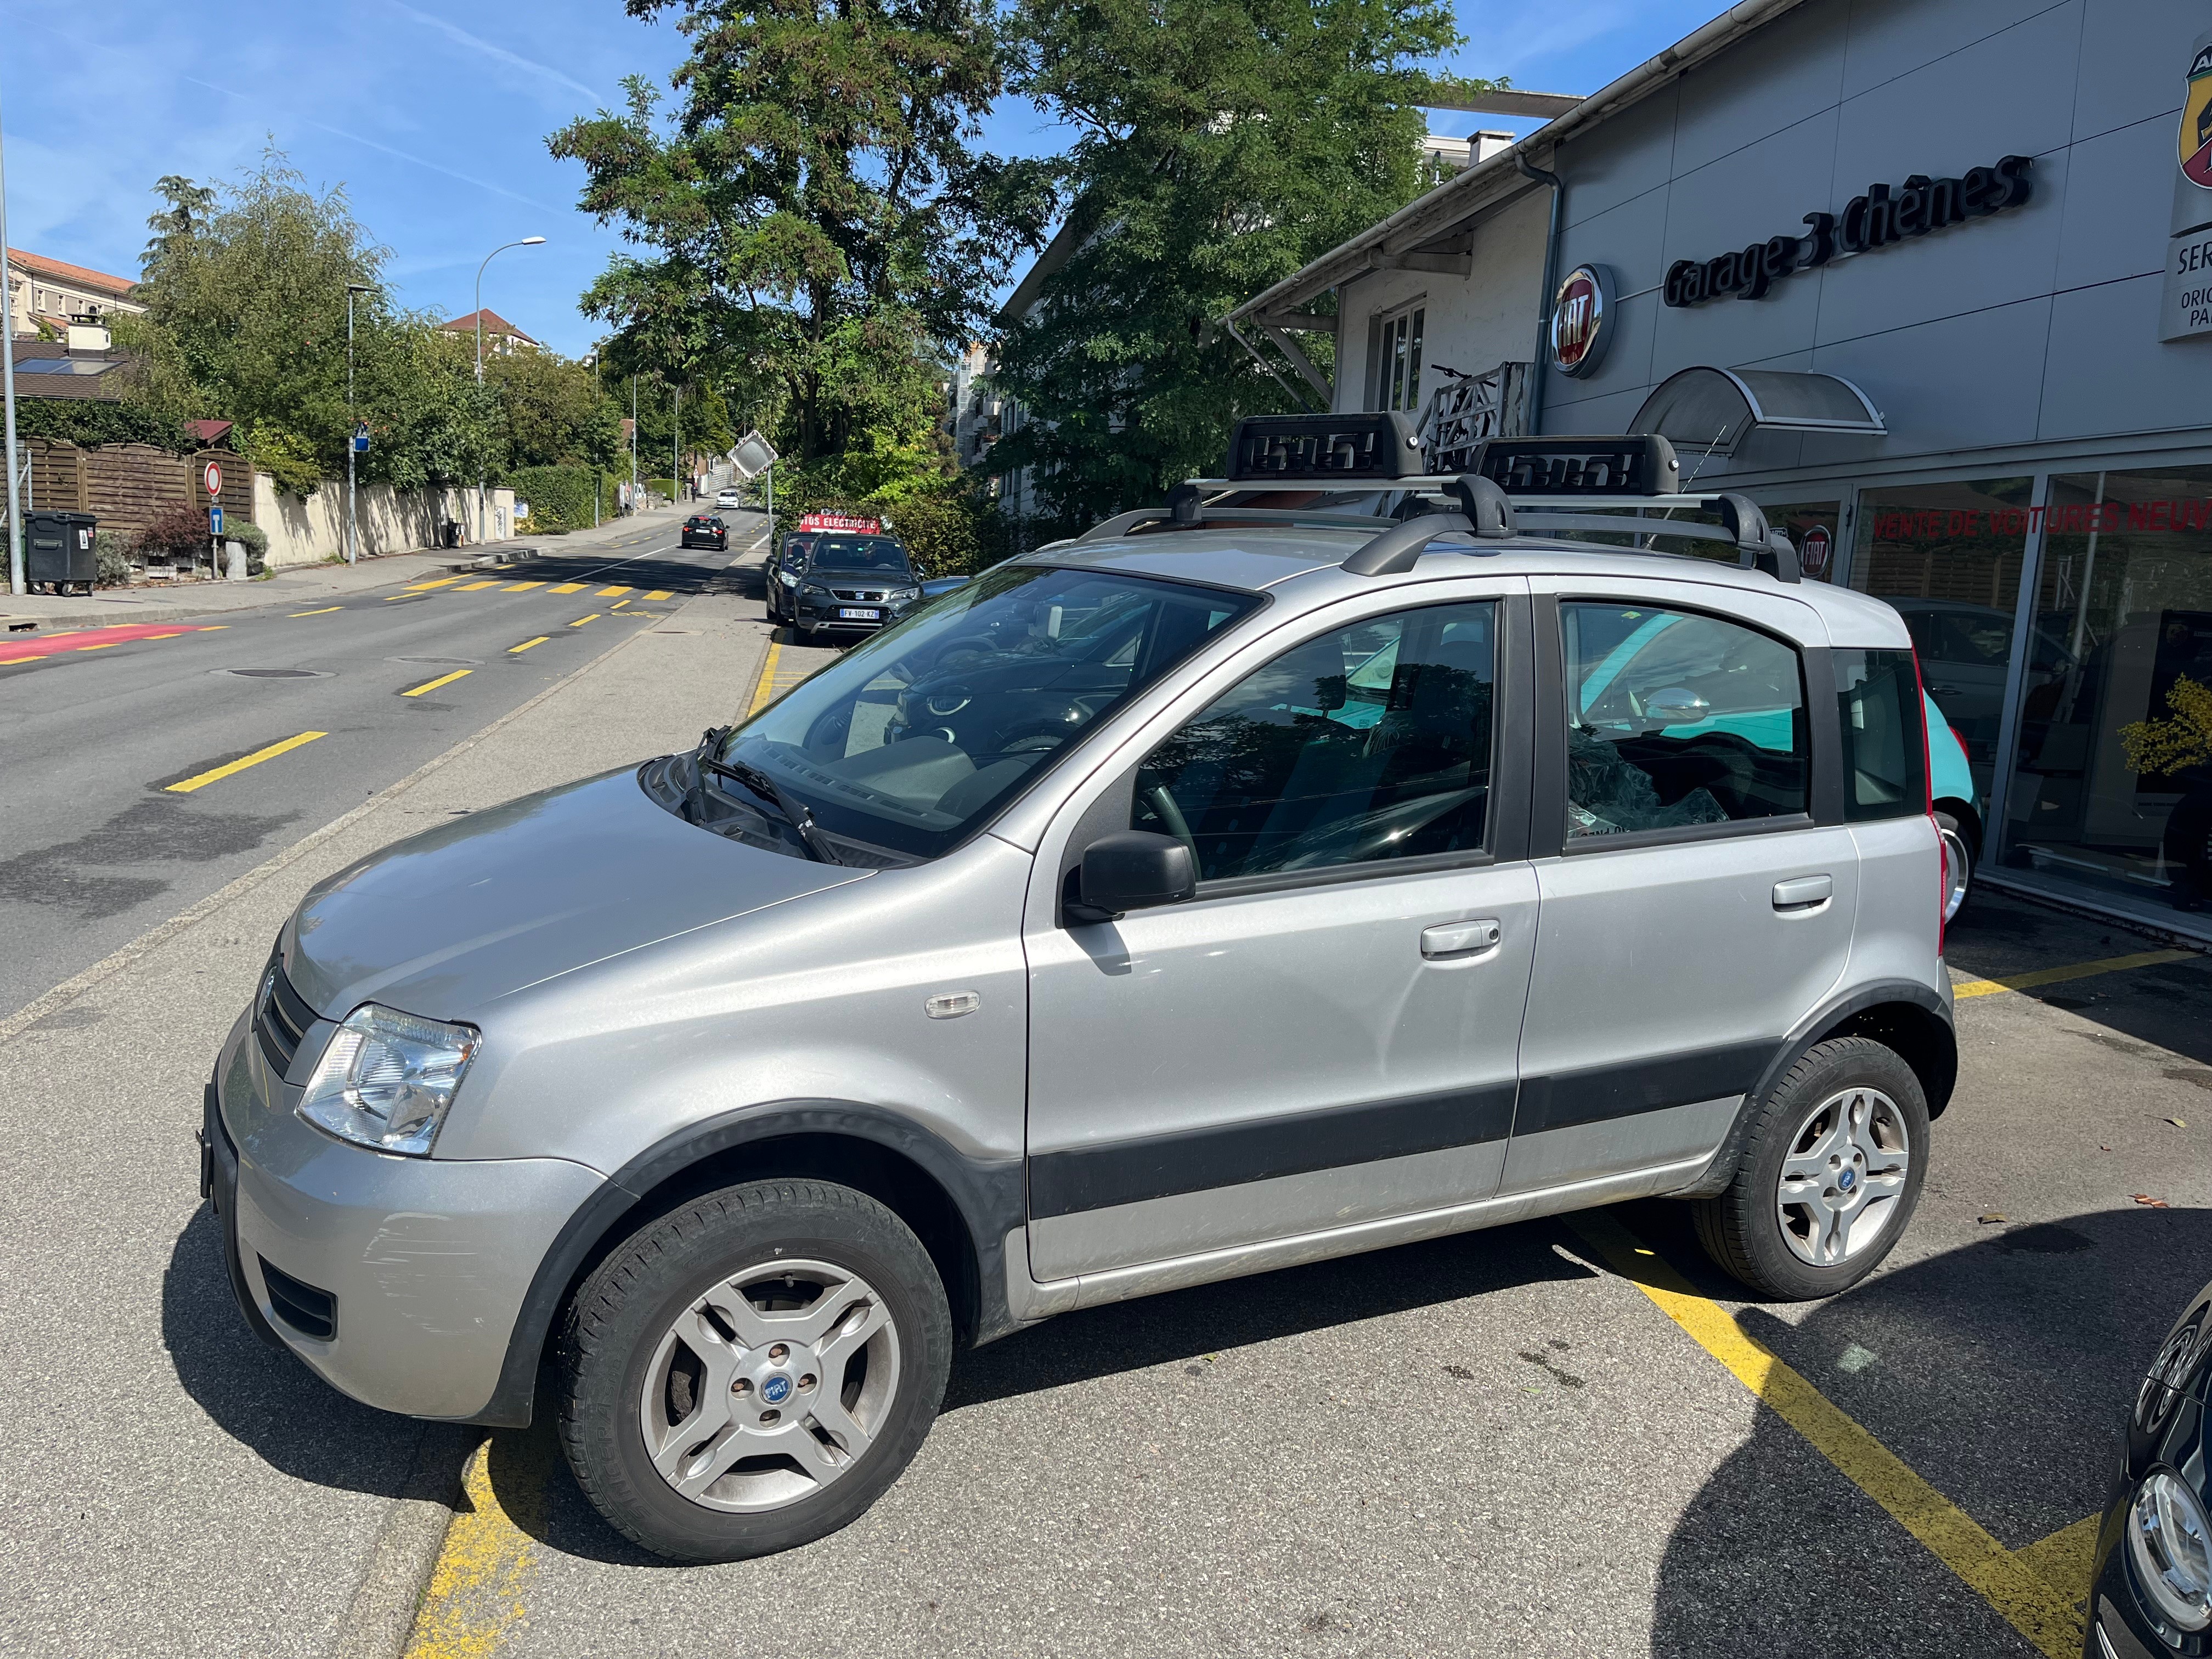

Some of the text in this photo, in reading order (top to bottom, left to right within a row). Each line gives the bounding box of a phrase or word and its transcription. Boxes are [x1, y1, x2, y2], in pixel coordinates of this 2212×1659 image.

[1664, 155, 2033, 307] Garage 3 Chênes
[1559, 294, 1589, 349] FIAT
[1874, 511, 1940, 539] VENTE
[1948, 510, 1978, 537] DE
[1989, 503, 2119, 536] VOITURES
[1805, 541, 1825, 565] FIAT
[765, 1380, 786, 1398] FIAT
[596, 1402, 652, 1521] SINCERA
